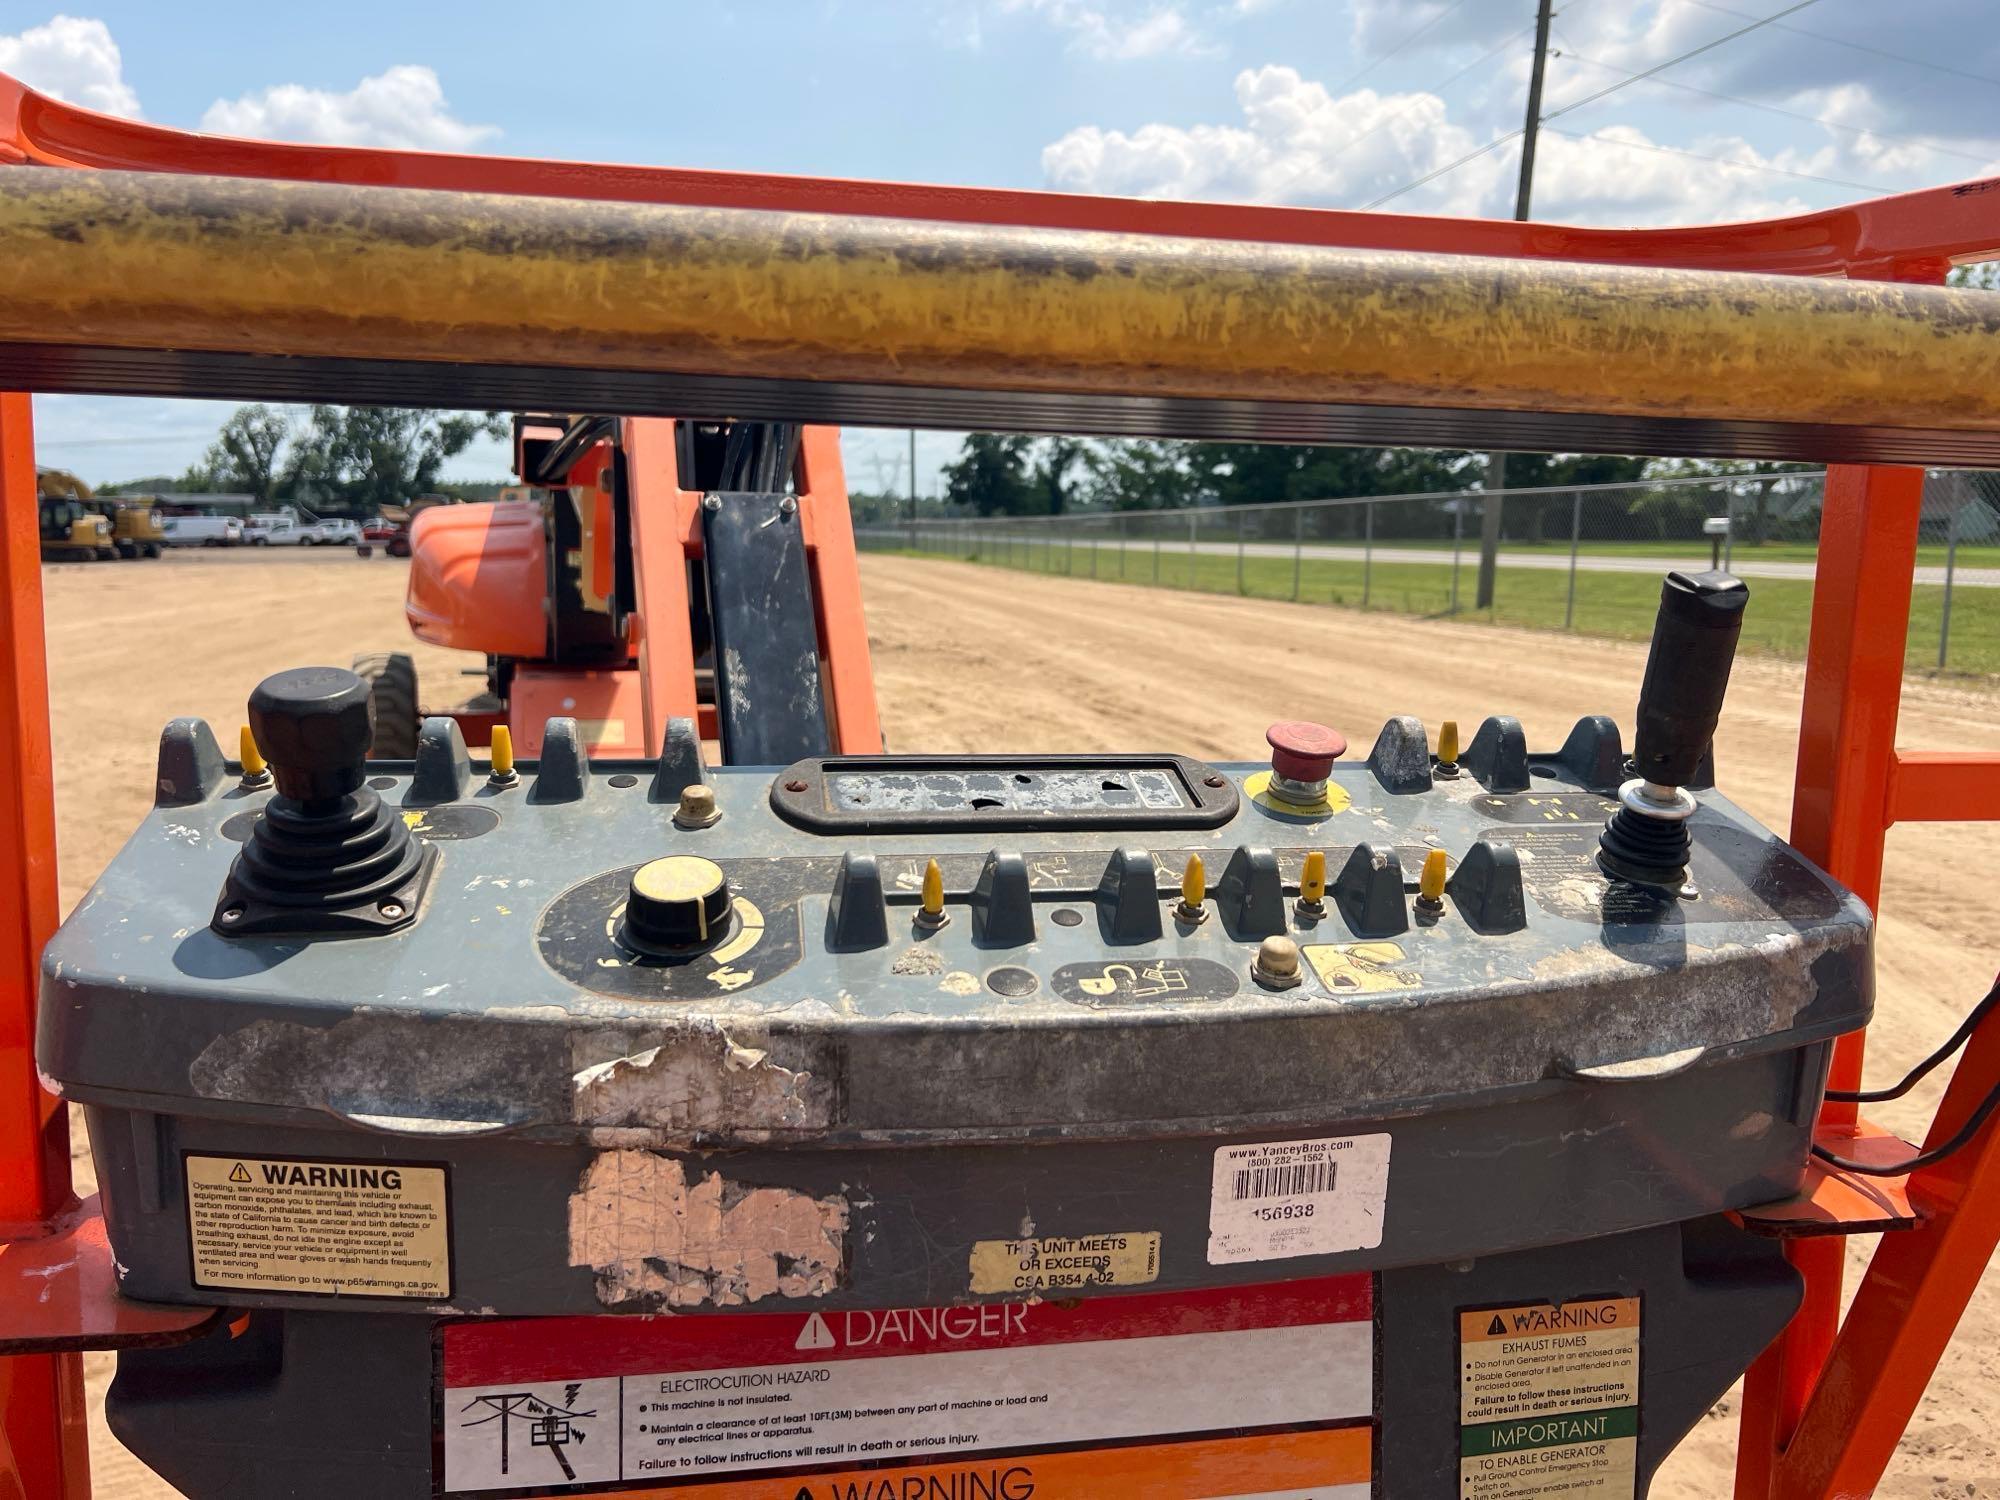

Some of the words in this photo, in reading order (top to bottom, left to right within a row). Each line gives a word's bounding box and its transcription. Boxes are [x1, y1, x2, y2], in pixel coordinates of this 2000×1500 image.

[1229, 1140, 1353, 1159] www.YanceyBros.com
[1248, 1158, 1271, 1168] (800)
[261, 1164, 401, 1190] WARNING
[237, 1186, 274, 1195] servicing
[294, 1189, 342, 1199] maintaining
[343, 1190, 359, 1198] this
[361, 1191, 390, 1199] vehicle
[194, 1201, 222, 1209] carbon
[224, 1203, 266, 1213] monoxide,
[399, 1211, 426, 1219] known
[209, 1211, 229, 1219] state
[231, 1212, 240, 1220] of
[242, 1212, 281, 1222] California
[368, 1219, 387, 1227] birth
[389, 1220, 419, 1228] defects
[1252, 1204, 1314, 1221] 156938
[196, 1229, 234, 1240] breathing
[332, 1237, 361, 1246] engine
[363, 1239, 391, 1247] except
[218, 1222, 269, 1231] reproduction
[297, 1225, 307, 1233] To
[309, 1227, 346, 1235] minimize
[348, 1229, 389, 1237] exposure,
[391, 1230, 414, 1238] avoid
[1042, 1241, 1075, 1254] UNIT
[1079, 1238, 1127, 1251] MEETS
[1020, 1259, 1040, 1271] OR
[1046, 1255, 1111, 1270] EXCEEDS
[203, 1268, 219, 1277] For
[221, 1271, 243, 1279] more
[246, 1272, 296, 1282] information
[298, 1276, 310, 1284] go
[1015, 1275, 1044, 1288] CSA
[846, 1303, 1027, 1346] DANGER
[1512, 1305, 1617, 1331] WARNING
[1502, 1339, 1549, 1354] EXHAUST
[1552, 1335, 1586, 1348] FUMES
[1474, 1360, 1486, 1369] Do
[1487, 1359, 1500, 1367] not
[1516, 1354, 1556, 1364] Generator
[1557, 1352, 1564, 1360] in
[1578, 1347, 1613, 1358] enclosed
[1474, 1372, 1502, 1381] Disable
[1504, 1367, 1544, 1378] Generator
[1552, 1364, 1564, 1373] left
[1565, 1360, 1610, 1371] unattended
[1612, 1359, 1619, 1367] in
[660, 1373, 772, 1393] ELECTROCUTION
[777, 1369, 830, 1384] HAZARD
[650, 1402, 669, 1411] This
[671, 1399, 715, 1410] machine
[717, 1398, 724, 1406] is
[727, 1396, 743, 1405] not
[746, 1393, 792, 1404] insulated.
[1474, 1395, 1504, 1405] Failure
[1518, 1390, 1545, 1400] follow
[1547, 1388, 1570, 1397] these
[1573, 1382, 1624, 1394] instructions
[651, 1422, 693, 1434] Maintain
[705, 1419, 756, 1429] clearance
[758, 1416, 768, 1425] of
[770, 1415, 781, 1424] at
[783, 1413, 806, 1423] least
[854, 1408, 895, 1417] between
[897, 1406, 915, 1415] any
[917, 1403, 937, 1414] part
[939, 1401, 948, 1410] of
[950, 1399, 992, 1409] machine
[1006, 1395, 1027, 1405] load
[1029, 1393, 1048, 1403] and
[1467, 1406, 1492, 1417] could
[1494, 1403, 1519, 1414] result
[1521, 1402, 1530, 1411] in
[1532, 1399, 1556, 1410] death
[1570, 1395, 1602, 1405] serious
[1605, 1392, 1631, 1403] injury.
[656, 1437, 675, 1446] any
[678, 1432, 723, 1444] electrical
[726, 1431, 748, 1440] lines
[762, 1426, 814, 1438] apparatus.
[1492, 1416, 1607, 1447] IMPORTANT
[638, 1458, 676, 1469] Failure
[679, 1456, 691, 1466] to
[694, 1454, 727, 1465] follow
[730, 1449, 792, 1462] instructions
[795, 1446, 812, 1456] will
[815, 1443, 844, 1455] result
[847, 1442, 857, 1452] in
[860, 1439, 892, 1451] death
[895, 1440, 907, 1448] or
[909, 1436, 945, 1447] serious
[949, 1434, 979, 1445] injury.
[1479, 1458, 1494, 1470] TO
[1497, 1453, 1537, 1468] ENABLE
[1540, 1444, 1605, 1462] GENERATOR
[1473, 1473, 1486, 1482] Pull
[1488, 1469, 1517, 1480] Ground
[1518, 1465, 1546, 1476] Control
[1548, 1461, 1590, 1472] Emergency
[832, 1467, 1035, 1500] WARNING
[1473, 1482, 1498, 1492] Switch
[1502, 1487, 1541, 1498] Generator
[1543, 1483, 1569, 1492] enable
[1571, 1479, 1594, 1488] switch
